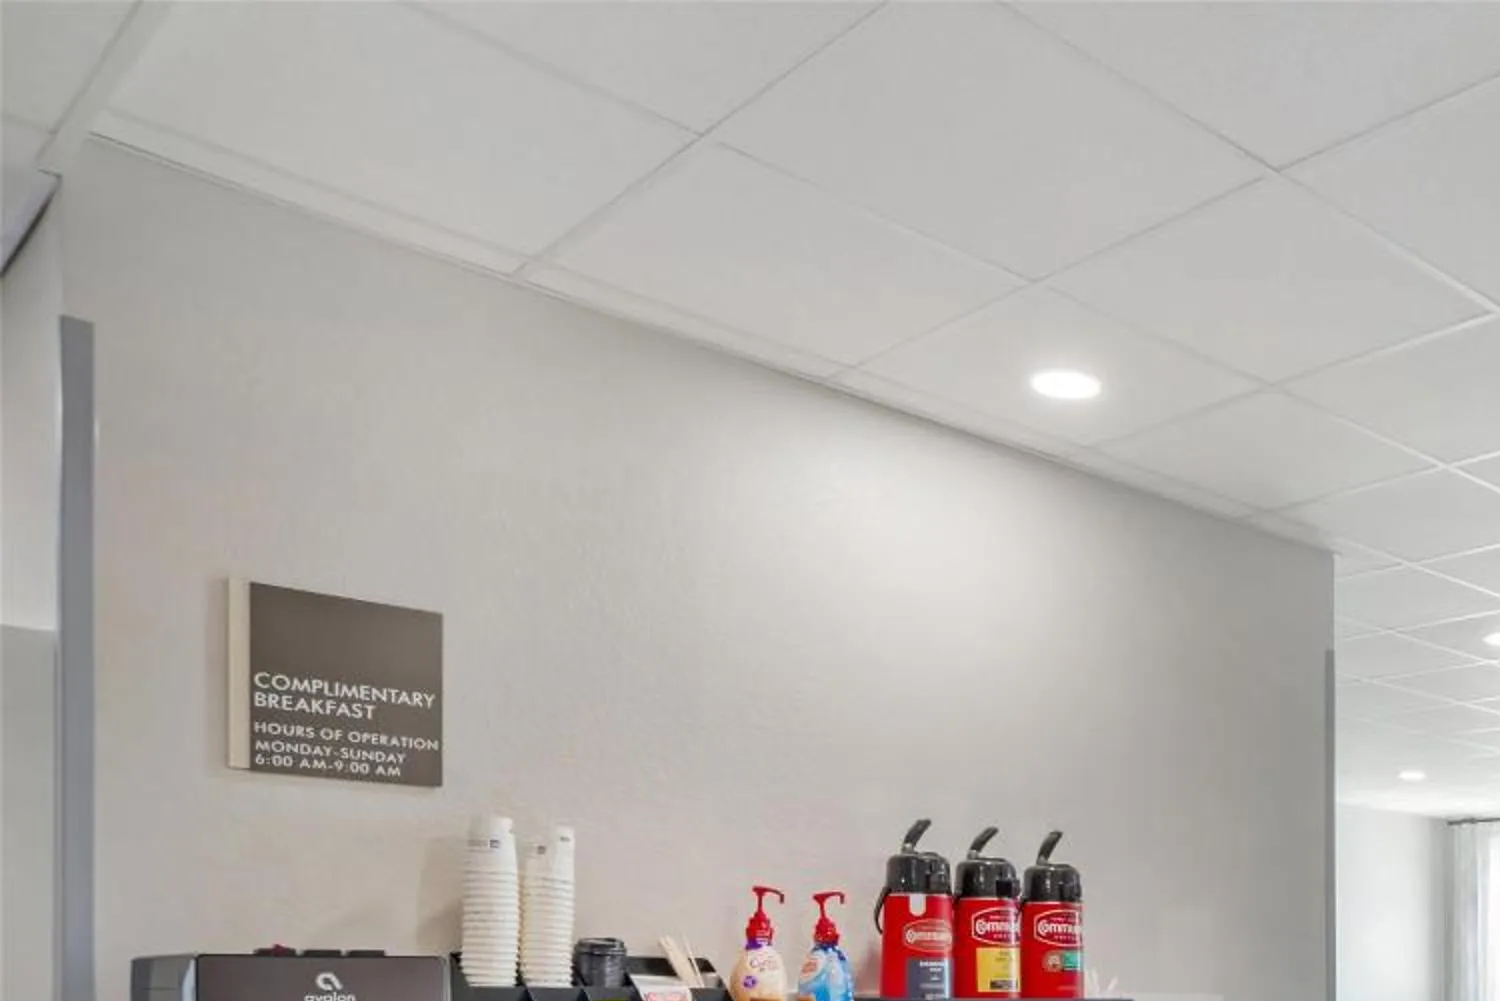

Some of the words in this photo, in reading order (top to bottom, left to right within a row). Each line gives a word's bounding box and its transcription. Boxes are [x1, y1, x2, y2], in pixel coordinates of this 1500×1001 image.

[254, 671, 436, 710] COMPLIMENTARY
[254, 691, 376, 720] BREAKFAST
[254, 721, 315, 739] HOURS
[320, 727, 343, 741] OF
[347, 731, 439, 751] OPERATION
[255, 740, 406, 764] MONDAY-SUNDAY
[255, 754, 293, 767] 6:00
[375, 764, 401, 777] AM
